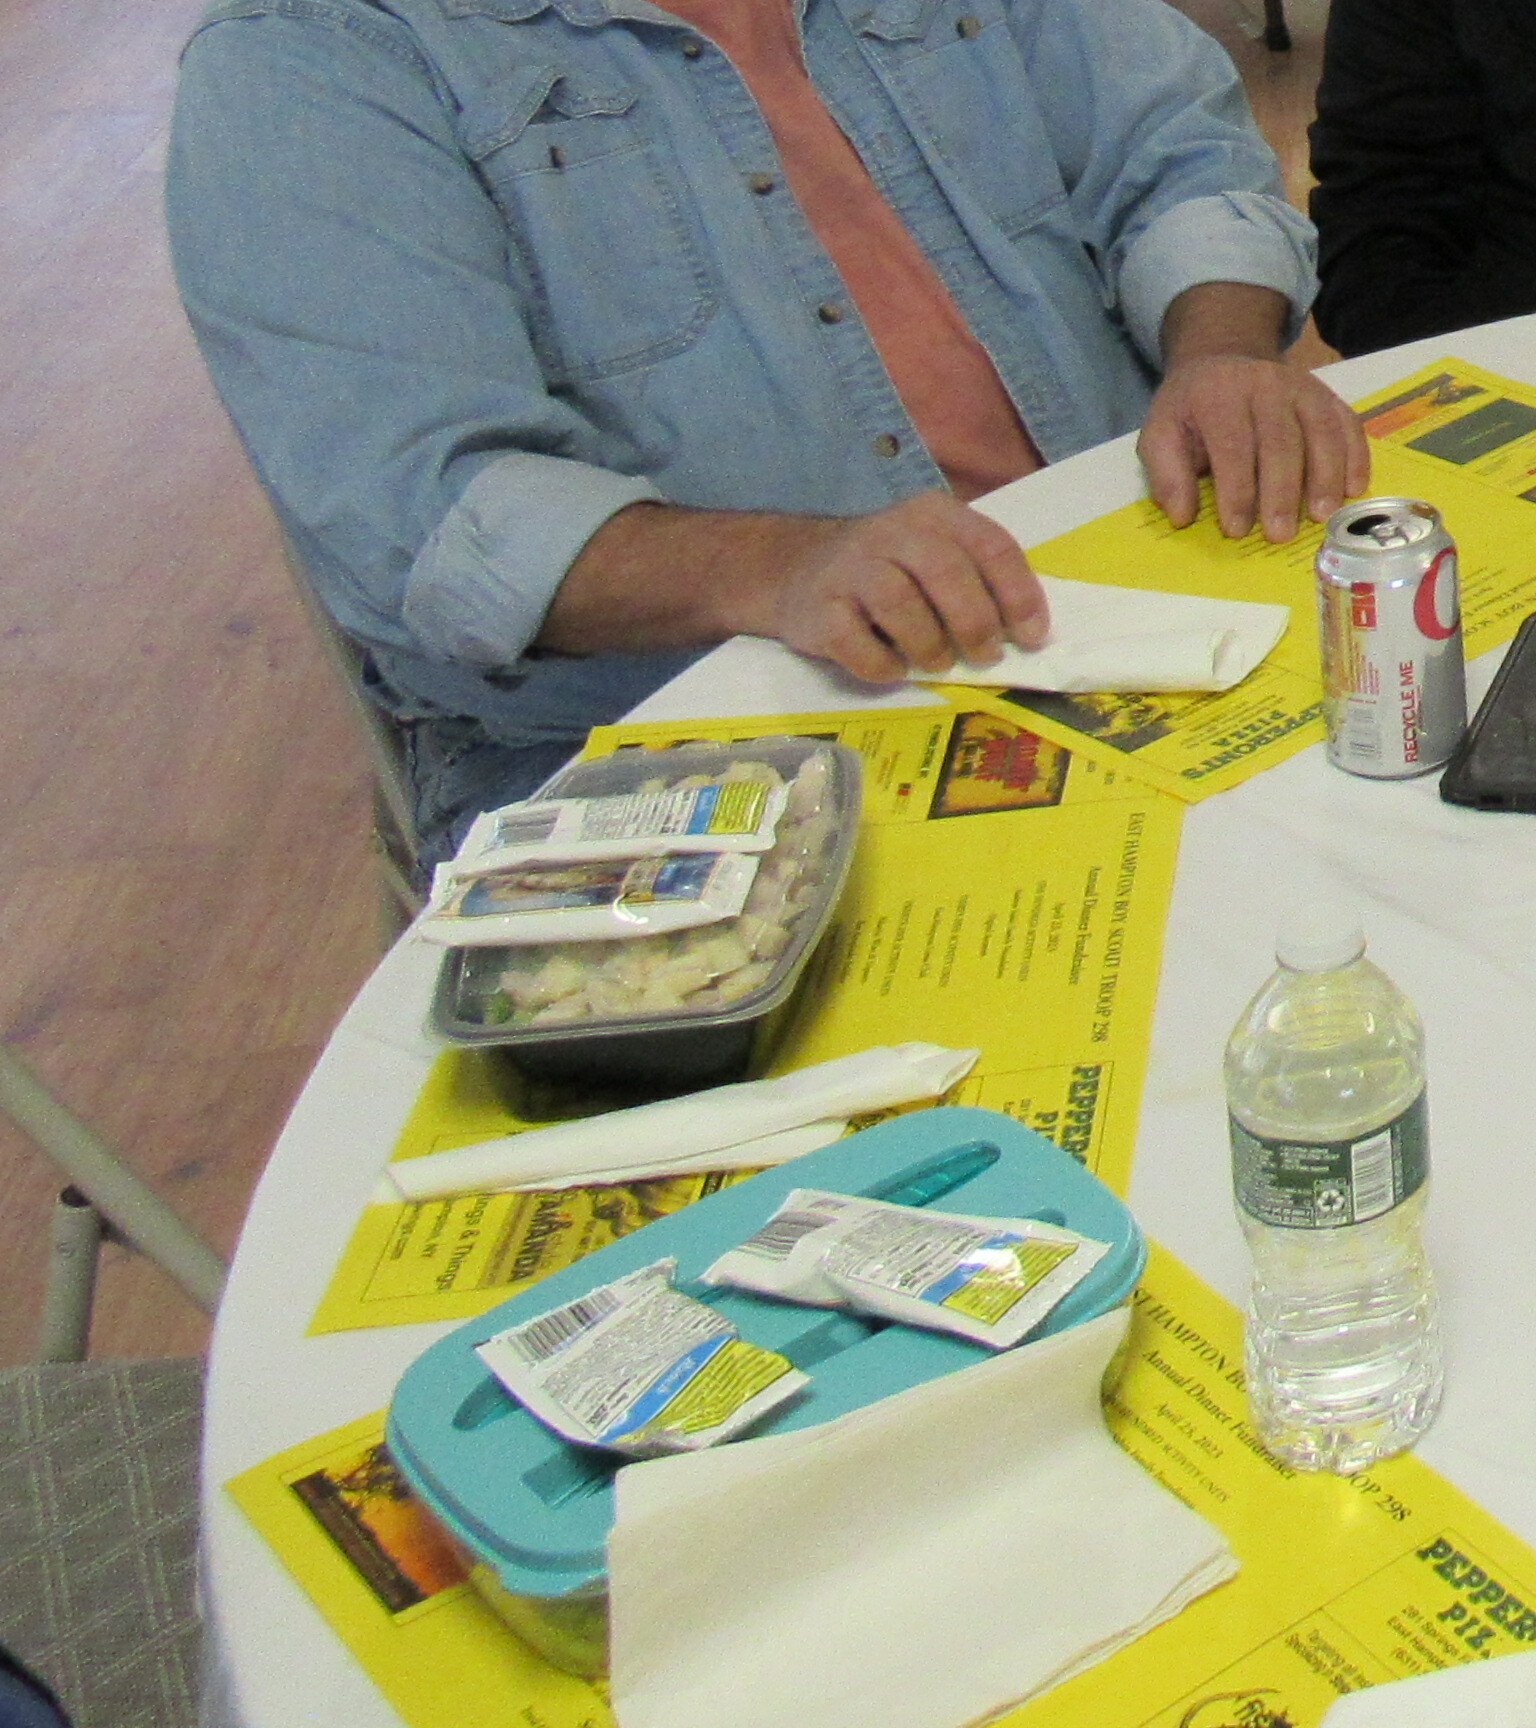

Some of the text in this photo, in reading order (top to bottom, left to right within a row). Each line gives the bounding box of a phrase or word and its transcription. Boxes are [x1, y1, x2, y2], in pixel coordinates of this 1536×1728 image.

[1401, 661, 1417, 763] RECYCLE ME
[1091, 811, 1145, 1042] EAST HAMPTON BOY SCOUT TROOP 298
[435, 1243, 474, 1290] Things
[1139, 1344, 1295, 1478] Annual Dinner Fundraiser
[1144, 1304, 1225, 1370] HAMPTON
[1376, 1494, 1411, 1521] 298
[1156, 1402, 1182, 1424] April
[1386, 1615, 1411, 1638] East
[1421, 1621, 1459, 1656] Springs
